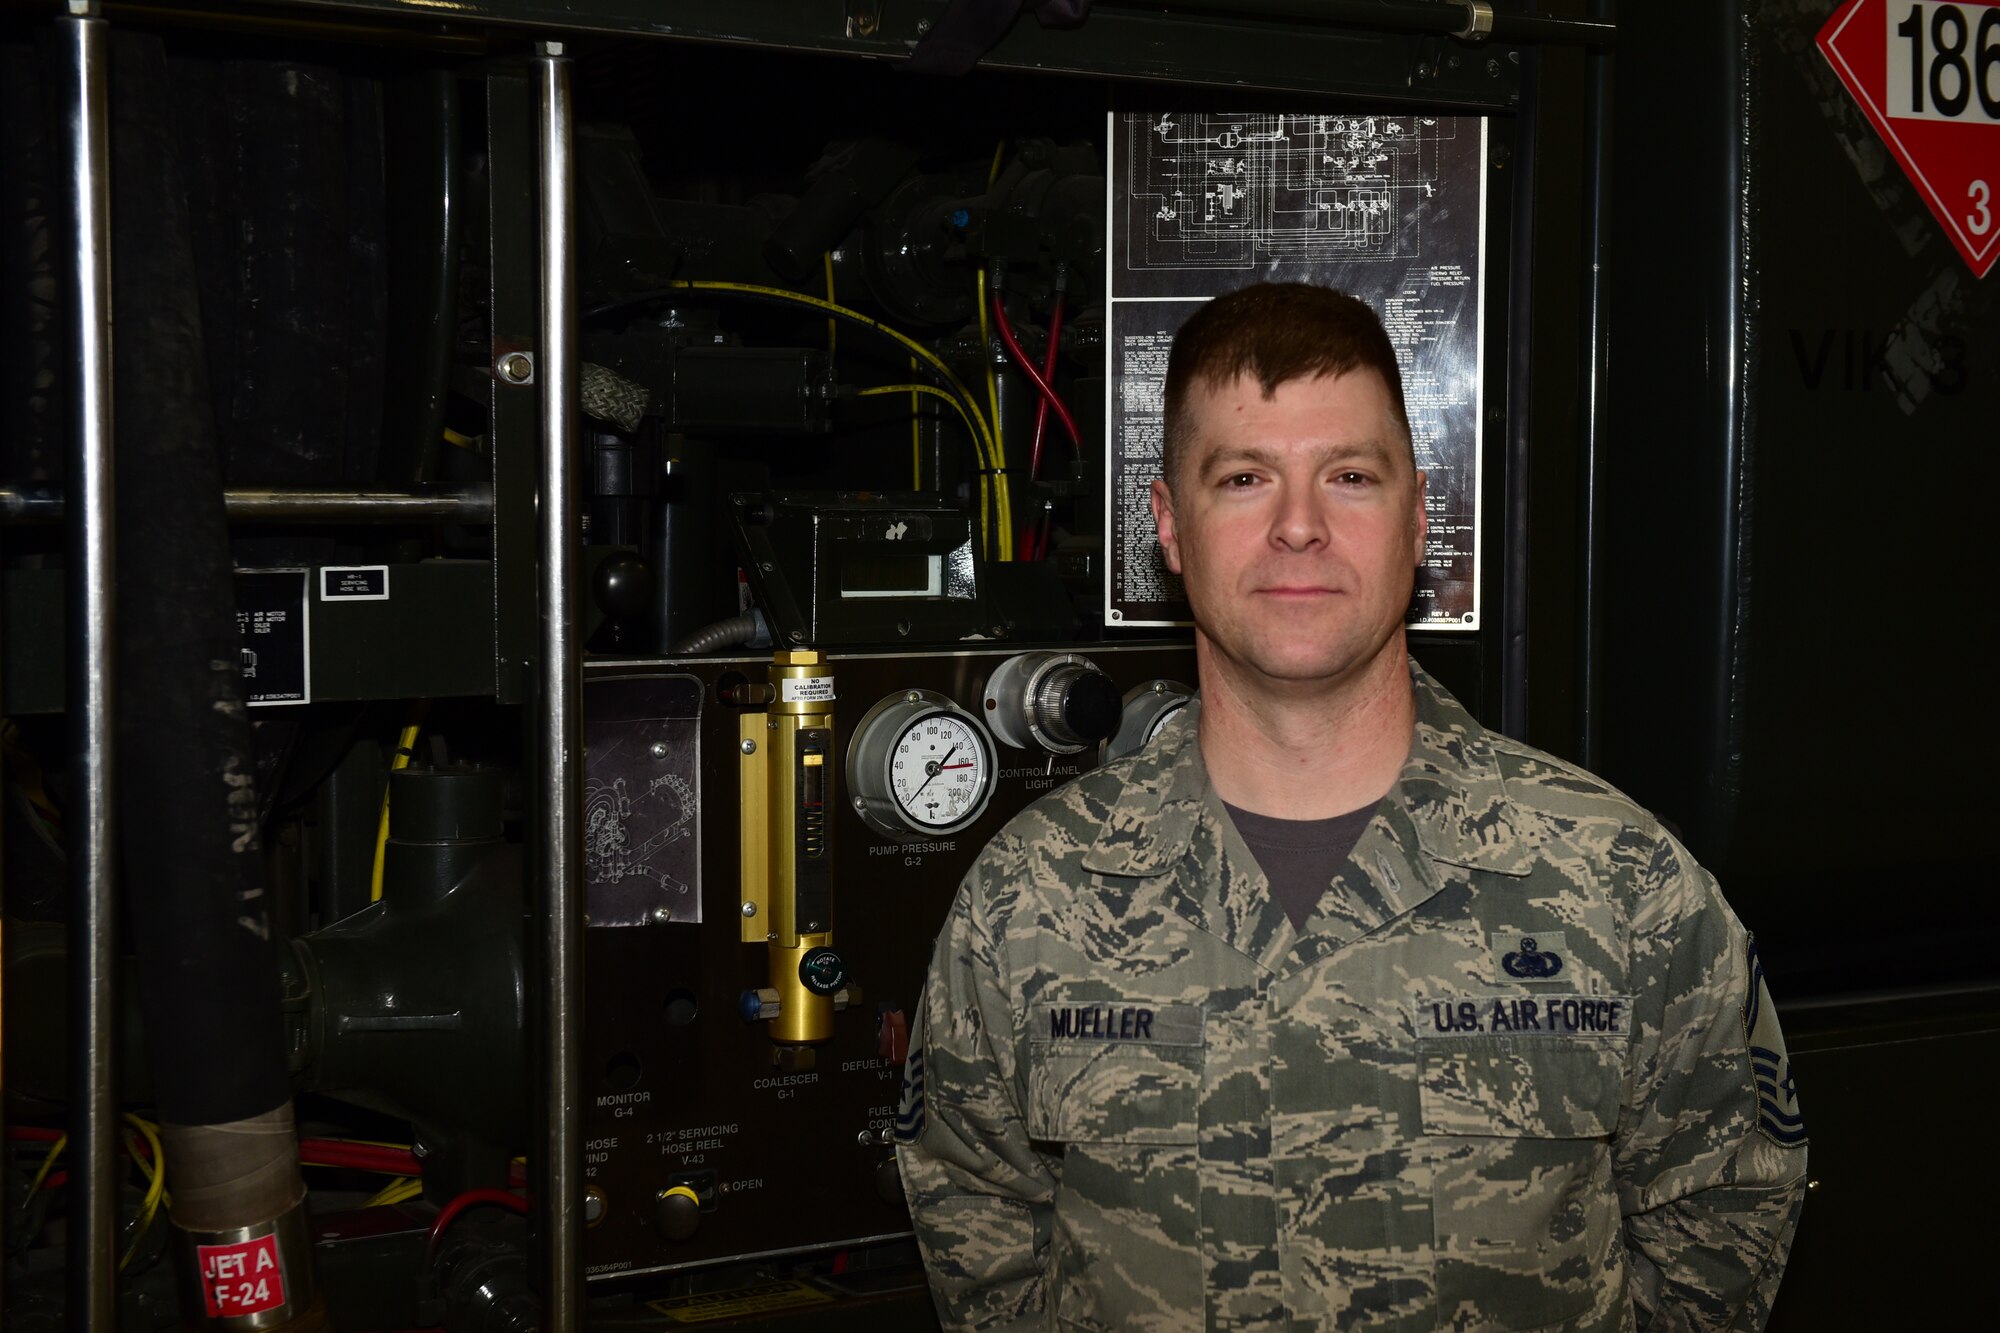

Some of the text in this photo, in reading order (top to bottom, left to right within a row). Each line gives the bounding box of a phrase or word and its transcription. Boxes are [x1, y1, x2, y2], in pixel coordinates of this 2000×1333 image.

[1966, 178, 1992, 236] 3
[912, 732, 921, 741] 80
[927, 727, 938, 735] 100
[940, 730, 952, 739] 120
[900, 745, 909, 753] 60
[998, 768, 1046, 778] CONTROL
[897, 779, 906, 787] 20
[1025, 779, 1054, 789] LIGHT
[869, 842, 956, 856] PUMP PRESSURE
[904, 857, 921, 866] G-2
[1434, 1000, 1620, 1032] U.S. AIR FORCE
[1051, 1008, 1154, 1040] MUELLER
[842, 1059, 882, 1072] DEFUEL
[753, 1072, 819, 1089] COALESCER
[878, 1070, 892, 1080] V-1
[596, 1091, 651, 1107] MONITOR
[778, 1089, 795, 1100] G-1
[614, 1107, 633, 1118] G-4
[868, 1105, 895, 1117] FUEL
[647, 1134, 654, 1143] 2
[679, 1124, 739, 1140] SERVICING
[586, 1137, 618, 1151] HOSE
[662, 1138, 724, 1155] HOSE REEL
[681, 1154, 705, 1165] V-43
[732, 1178, 763, 1191] OPEN
[205, 1248, 274, 1279] JET A
[215, 1278, 270, 1309] F-24
